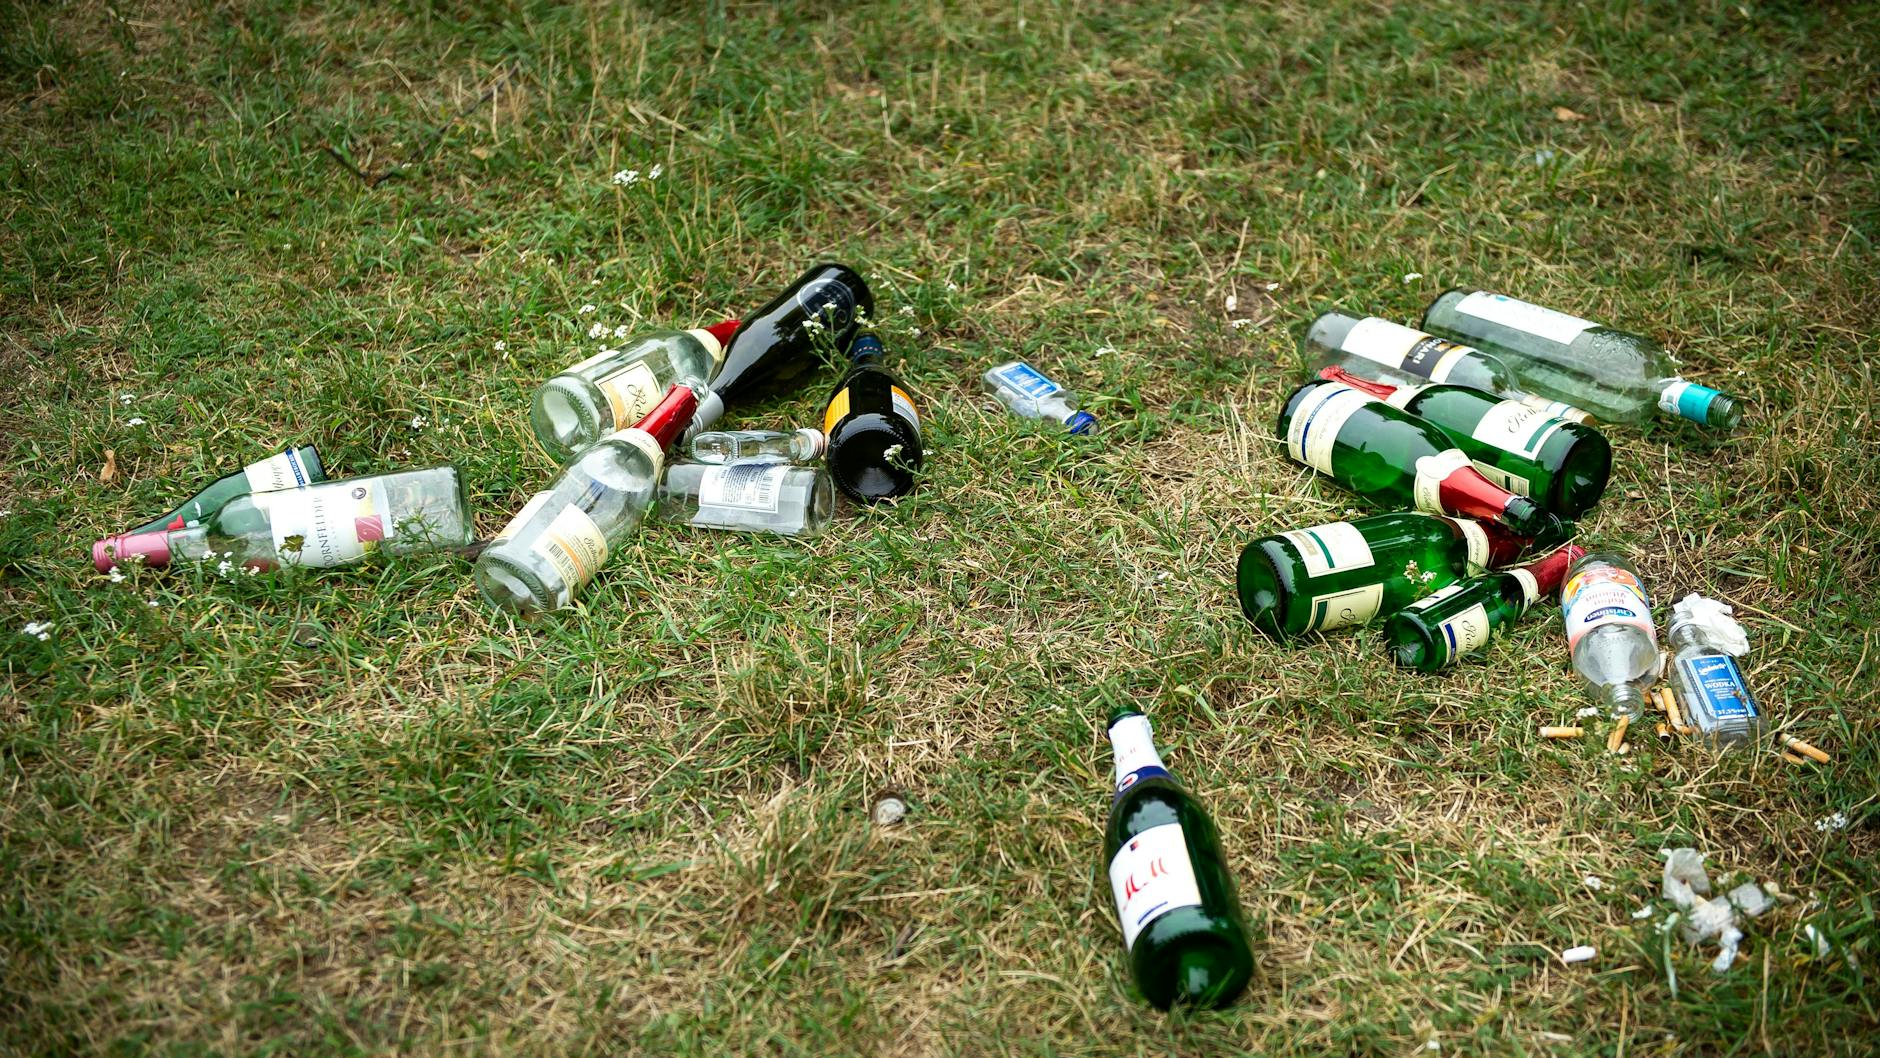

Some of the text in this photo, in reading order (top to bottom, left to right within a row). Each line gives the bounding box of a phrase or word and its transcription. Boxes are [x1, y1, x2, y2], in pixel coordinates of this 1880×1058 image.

[313, 497, 336, 568] DORNFELDER
[1586, 607, 1634, 621] Christinen
[1704, 681, 1735, 689] WODKA
